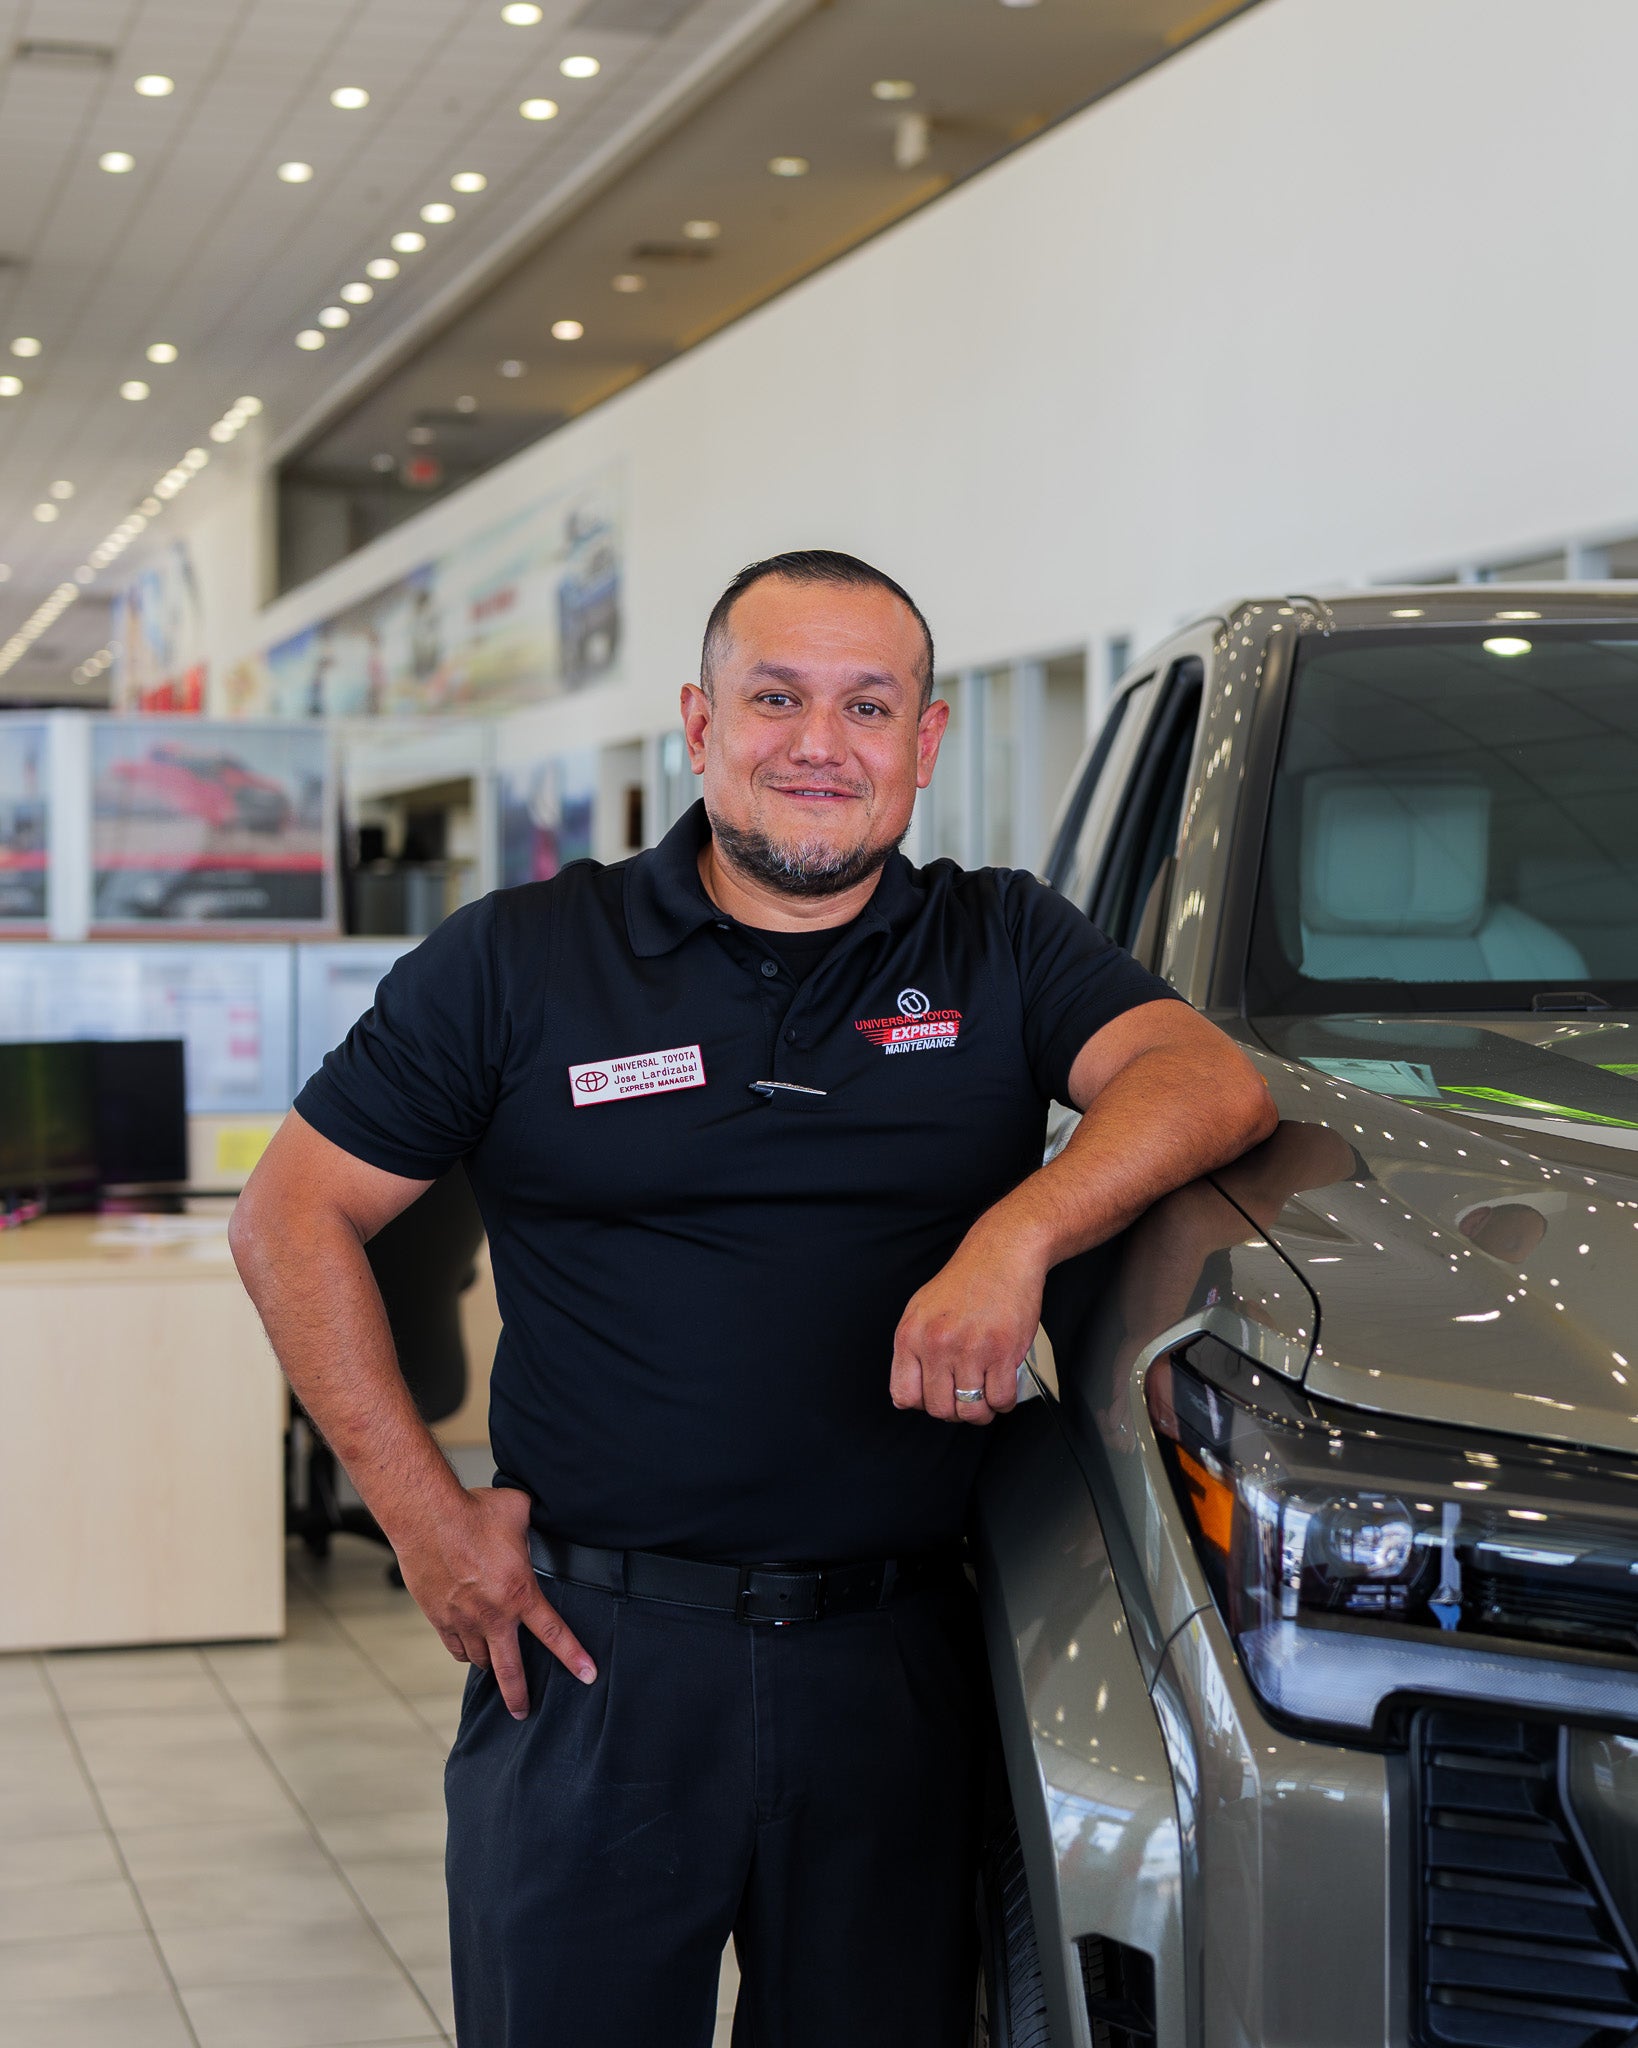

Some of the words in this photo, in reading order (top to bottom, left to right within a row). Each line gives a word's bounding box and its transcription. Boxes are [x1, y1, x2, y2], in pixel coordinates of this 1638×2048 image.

[854, 1012, 919, 1030] UNIVERSAL
[922, 1009, 963, 1022] TOYOTA
[891, 1021, 955, 1041] EXPRESS
[885, 1037, 957, 1055] MAINTENANCE
[611, 1057, 659, 1073] UNIVERSAL
[662, 1051, 695, 1064] TOYOTA
[614, 1074, 637, 1085] Jose
[642, 1062, 698, 1080] Lardizabal
[619, 1082, 655, 1094] EXPRESS
[658, 1075, 695, 1087] MANAGER
